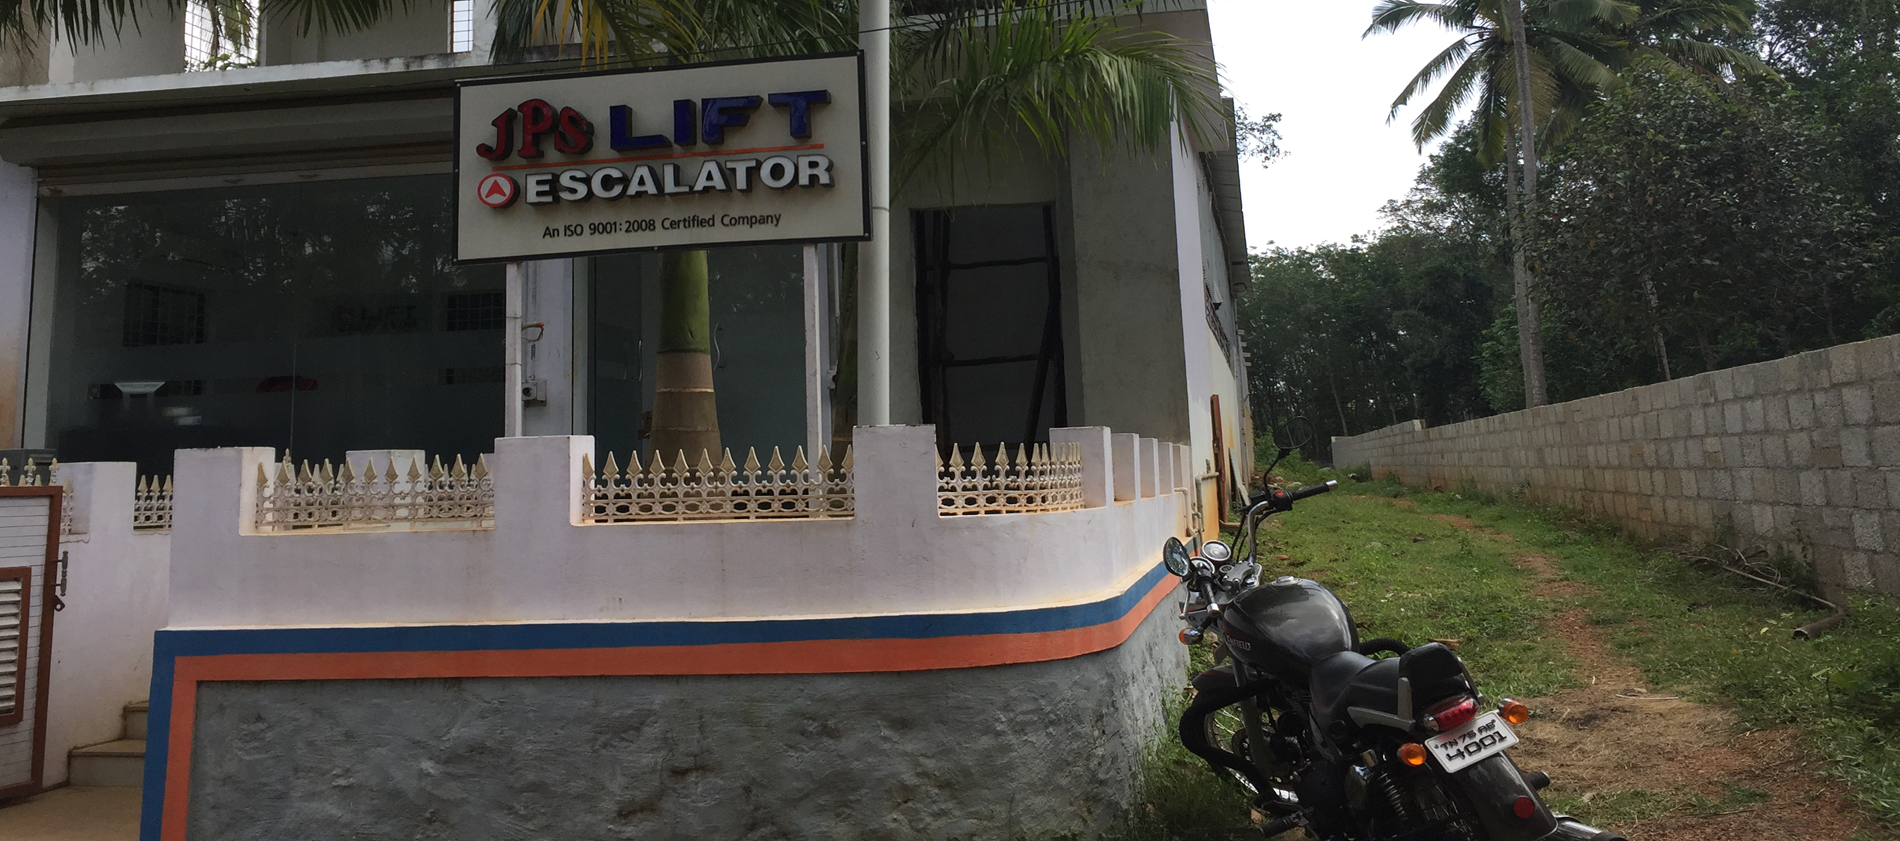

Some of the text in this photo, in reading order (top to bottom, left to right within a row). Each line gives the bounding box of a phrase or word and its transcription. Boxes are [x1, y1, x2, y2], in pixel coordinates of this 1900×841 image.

[476, 89, 832, 161] JPS LIFT
[525, 154, 835, 206] ESCALATOR
[542, 211, 781, 239] An ISO 9001:2008 Certified Company
[1440, 738, 1458, 751] TN
[1459, 730, 1476, 743] 75
[1446, 731, 1507, 761] 4001
